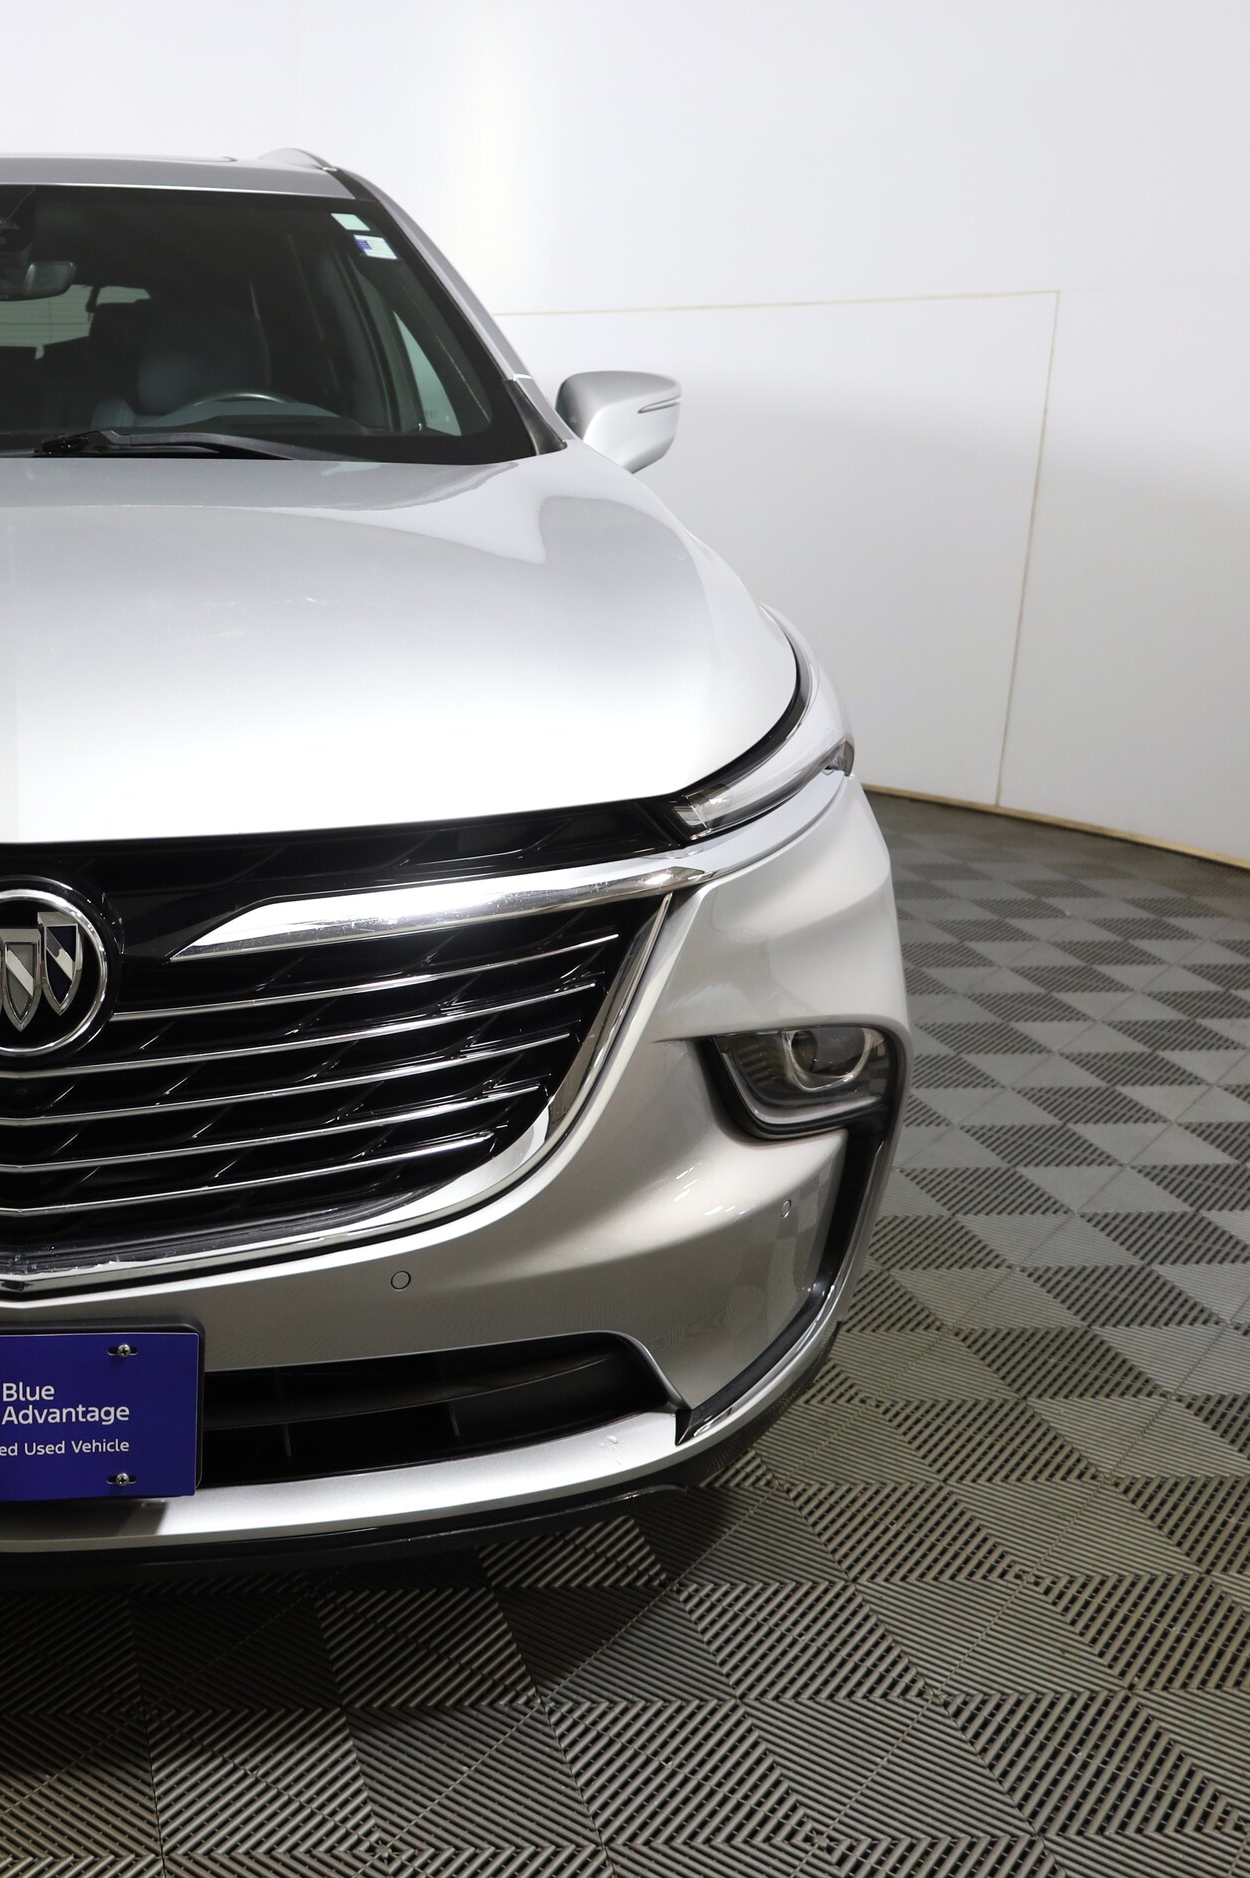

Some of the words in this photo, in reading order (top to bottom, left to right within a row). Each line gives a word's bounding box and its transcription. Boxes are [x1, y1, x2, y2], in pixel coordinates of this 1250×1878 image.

[2, 1381, 55, 1402] Blue
[1, 1403, 130, 1426] Advantage
[24, 1440, 66, 1456] Used
[70, 1438, 130, 1454] Vehicle
